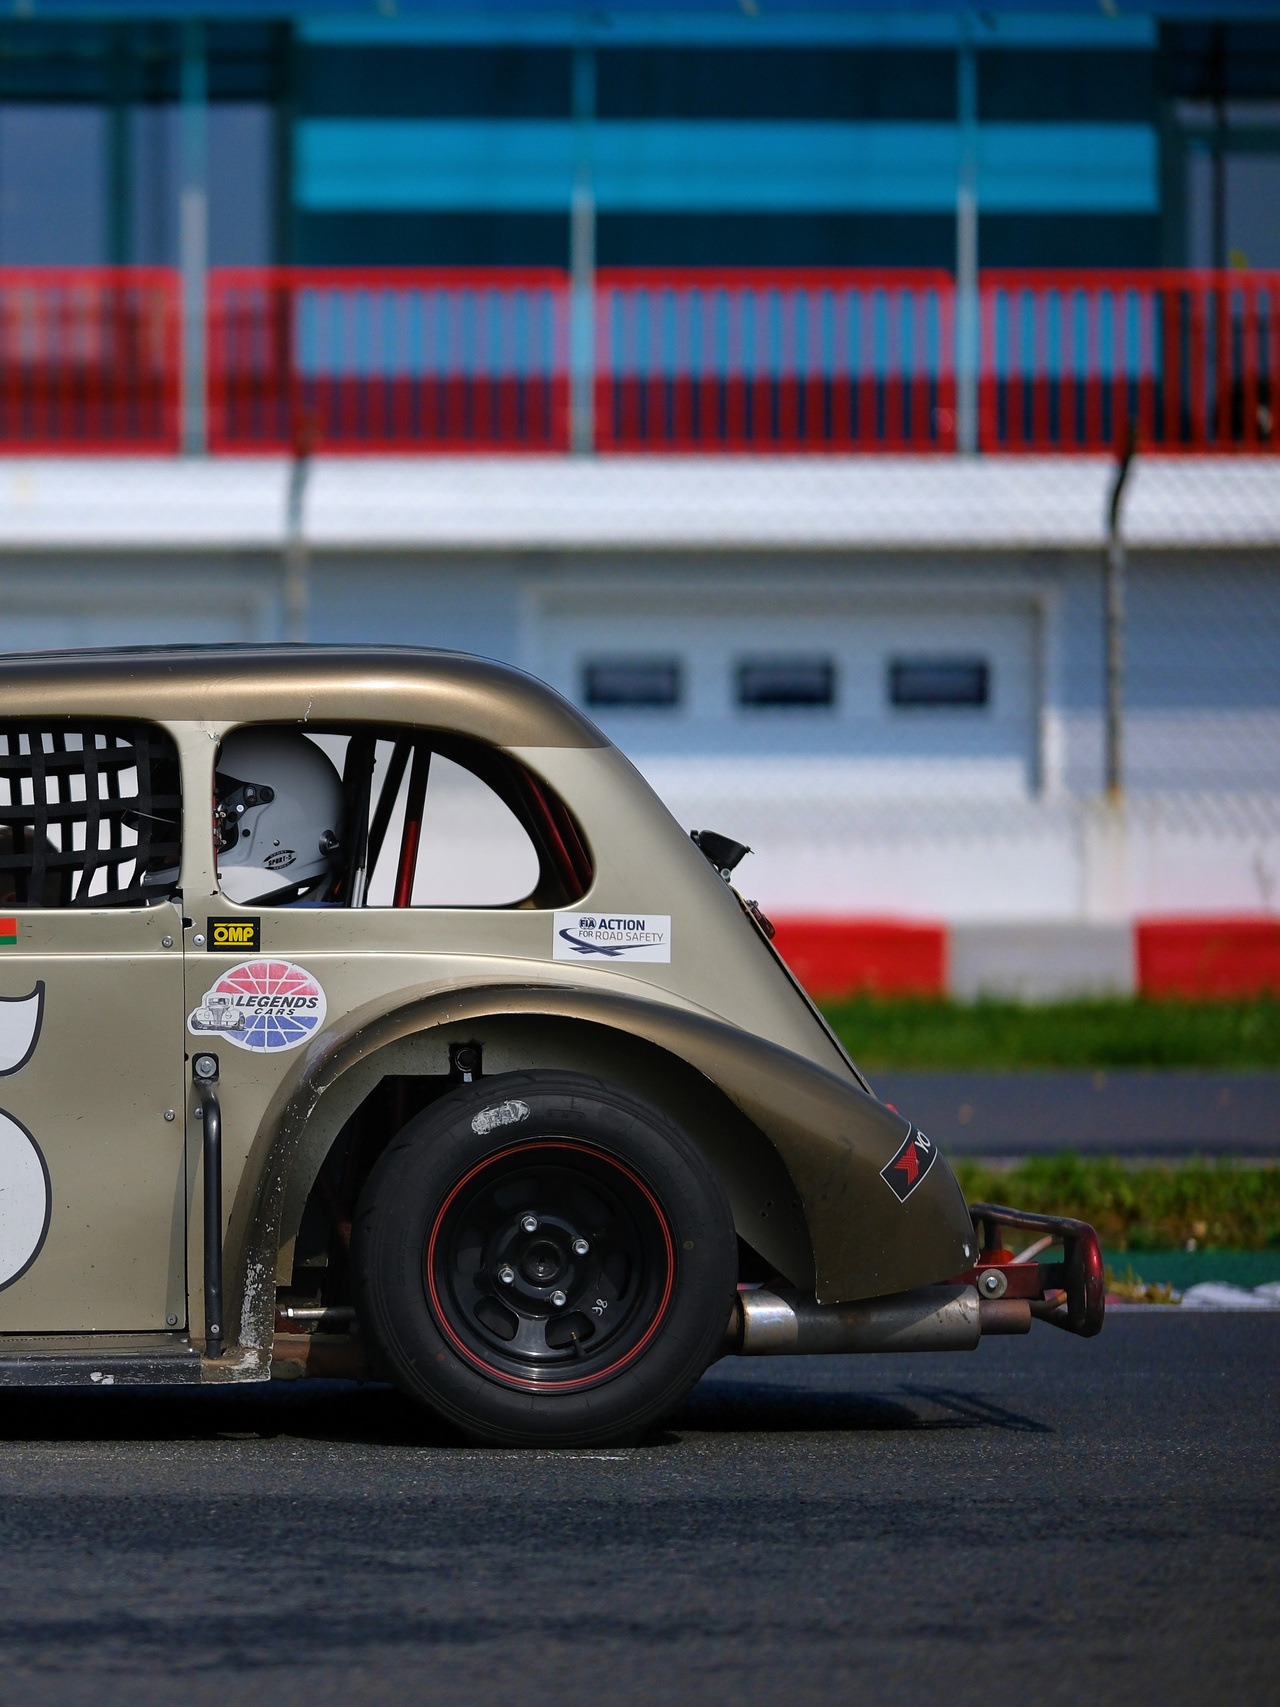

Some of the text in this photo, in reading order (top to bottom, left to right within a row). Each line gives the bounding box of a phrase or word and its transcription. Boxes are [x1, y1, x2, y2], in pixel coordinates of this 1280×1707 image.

[579, 919, 645, 931] FIA ACTION
[214, 927, 254, 942] OMP
[579, 930, 664, 942] FOR ROAD SAFETY
[235, 996, 319, 1009] LEGENDS
[254, 1008, 295, 1016] CARS
